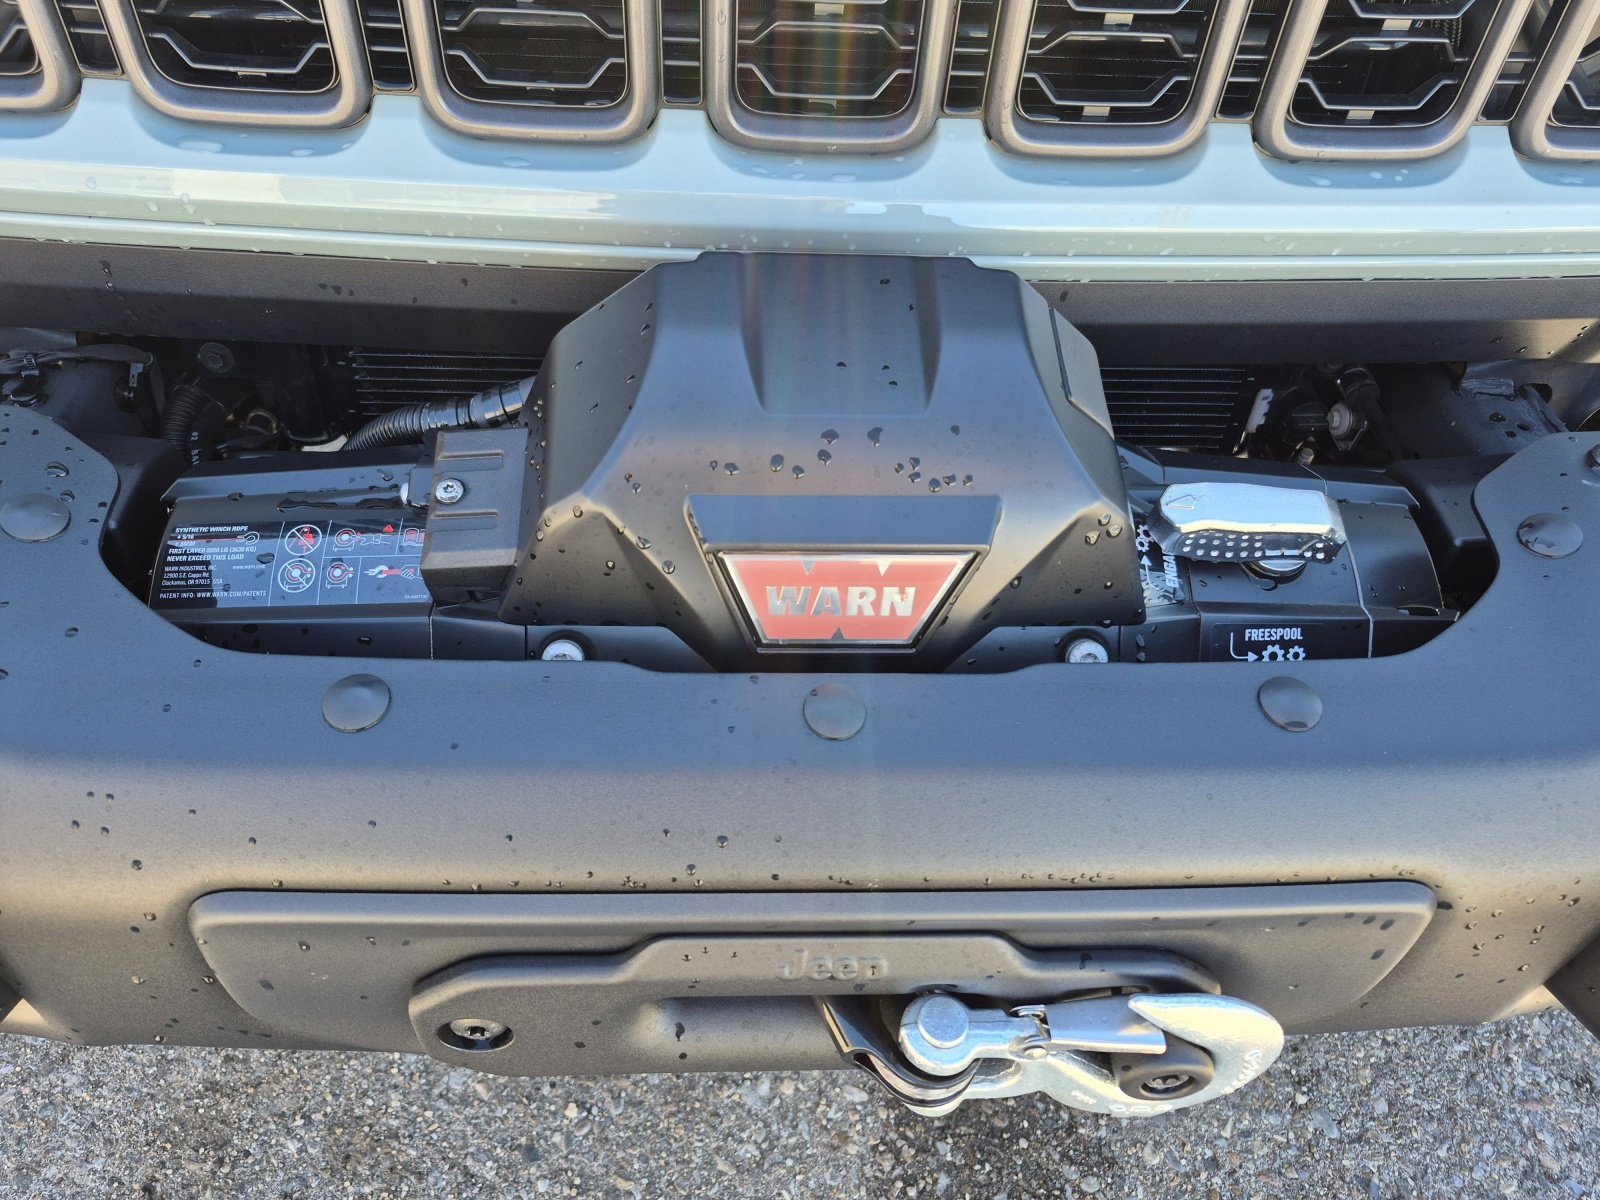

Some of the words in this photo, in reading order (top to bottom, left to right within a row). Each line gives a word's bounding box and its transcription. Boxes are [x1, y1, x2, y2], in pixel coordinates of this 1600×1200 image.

[1162, 555, 1180, 587] ENGA
[766, 586, 916, 617] WARN
[1244, 628, 1303, 642] FREESPOOL
